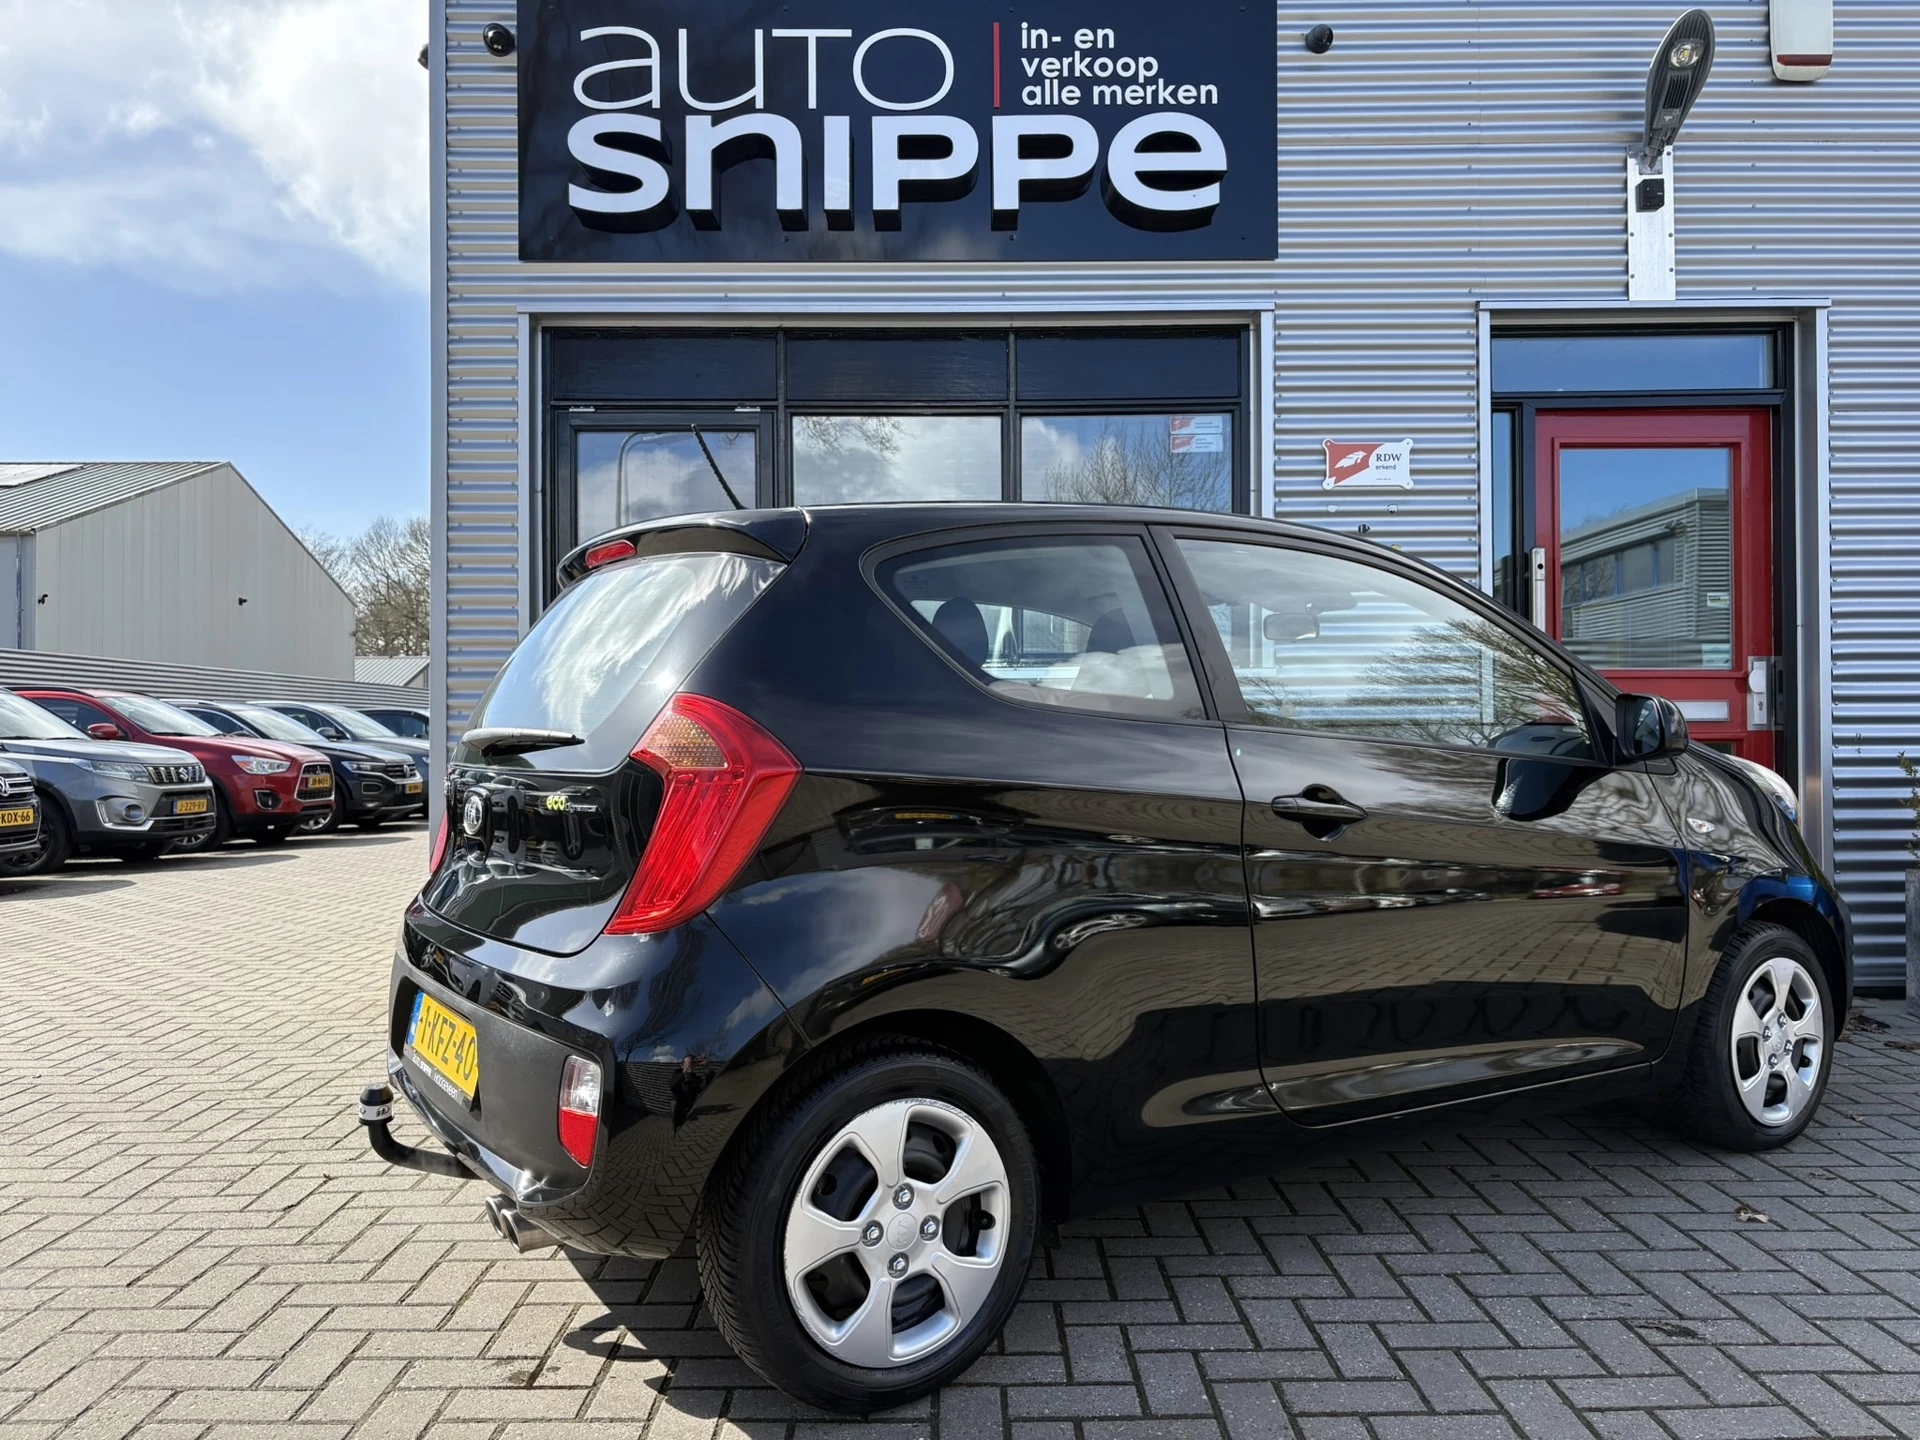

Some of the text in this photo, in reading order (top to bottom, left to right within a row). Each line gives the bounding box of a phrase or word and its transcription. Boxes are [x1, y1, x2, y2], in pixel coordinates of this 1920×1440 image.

[1021, 21, 1115, 49] in- en
[1021, 50, 1159, 83] verkoop
[1022, 78, 1218, 106] alle merken
[1376, 453, 1402, 462] RDW
